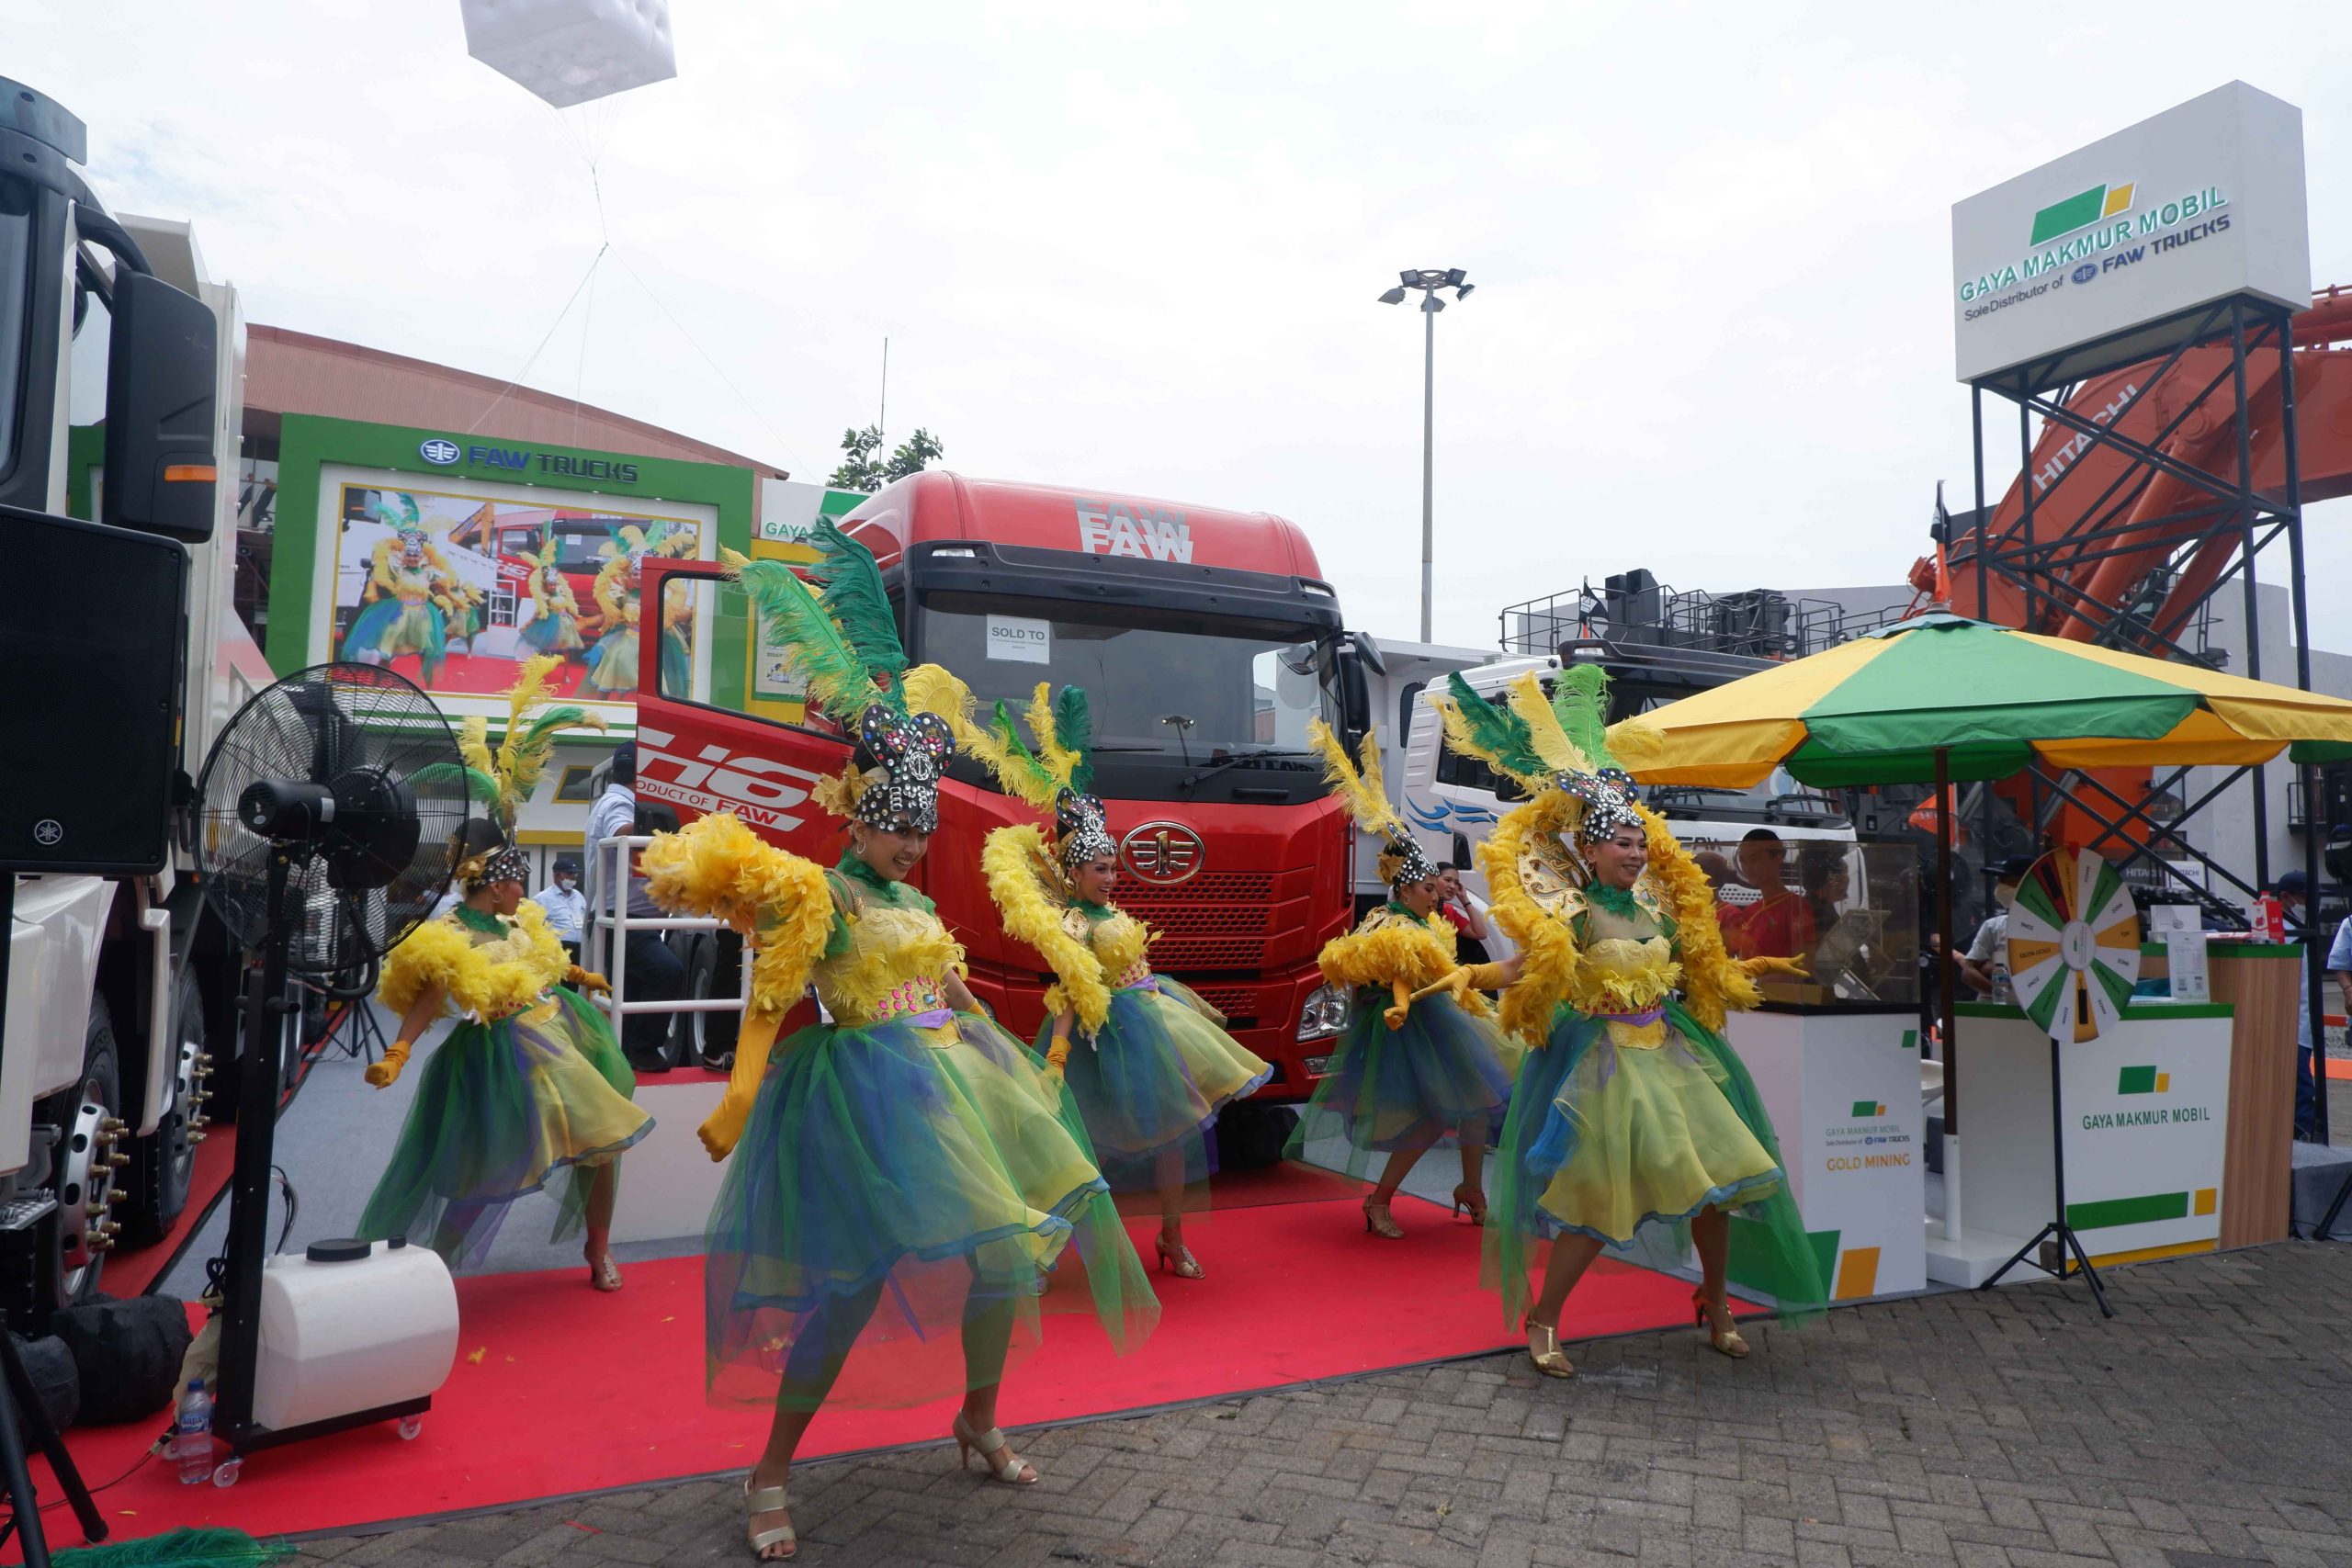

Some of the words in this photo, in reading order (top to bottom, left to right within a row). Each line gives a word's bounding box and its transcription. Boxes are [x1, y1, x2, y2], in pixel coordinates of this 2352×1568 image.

[1961, 265, 2018, 302] GAYA
[2023, 220, 2133, 279] MAKMUR
[2139, 186, 2228, 236] MOBIL
[1964, 305, 1989, 321] Sole
[1990, 283, 2050, 312] Distributor
[2052, 275, 2064, 289] of
[2102, 245, 2145, 274] FAW
[2150, 214, 2230, 254] TRUCKS
[468, 446, 530, 471] FAW
[537, 453, 639, 483] TRUCKS
[765, 522, 808, 538] GAYA
[1080, 526, 1193, 564] FAW
[991, 626, 1025, 638] SOLD
[1028, 630, 1046, 640] TO
[636, 780, 687, 800] ODUCT
[689, 795, 709, 806] OF
[716, 798, 779, 826] FAW
[2028, 976, 2040, 987] ZONK
[2082, 1113, 2113, 1130] GAYA
[2116, 1110, 2168, 1128] MAKMUR
[2172, 1107, 2211, 1123] MOBIL
[1826, 1128, 1845, 1136] GAYA
[1847, 1125, 1878, 1135] MAKMUR
[1880, 1124, 1900, 1134] MOBIL
[1826, 1156, 1861, 1171] GOLD
[1865, 1153, 1911, 1168] MINING
[182, 1416, 202, 1426] AQUA
